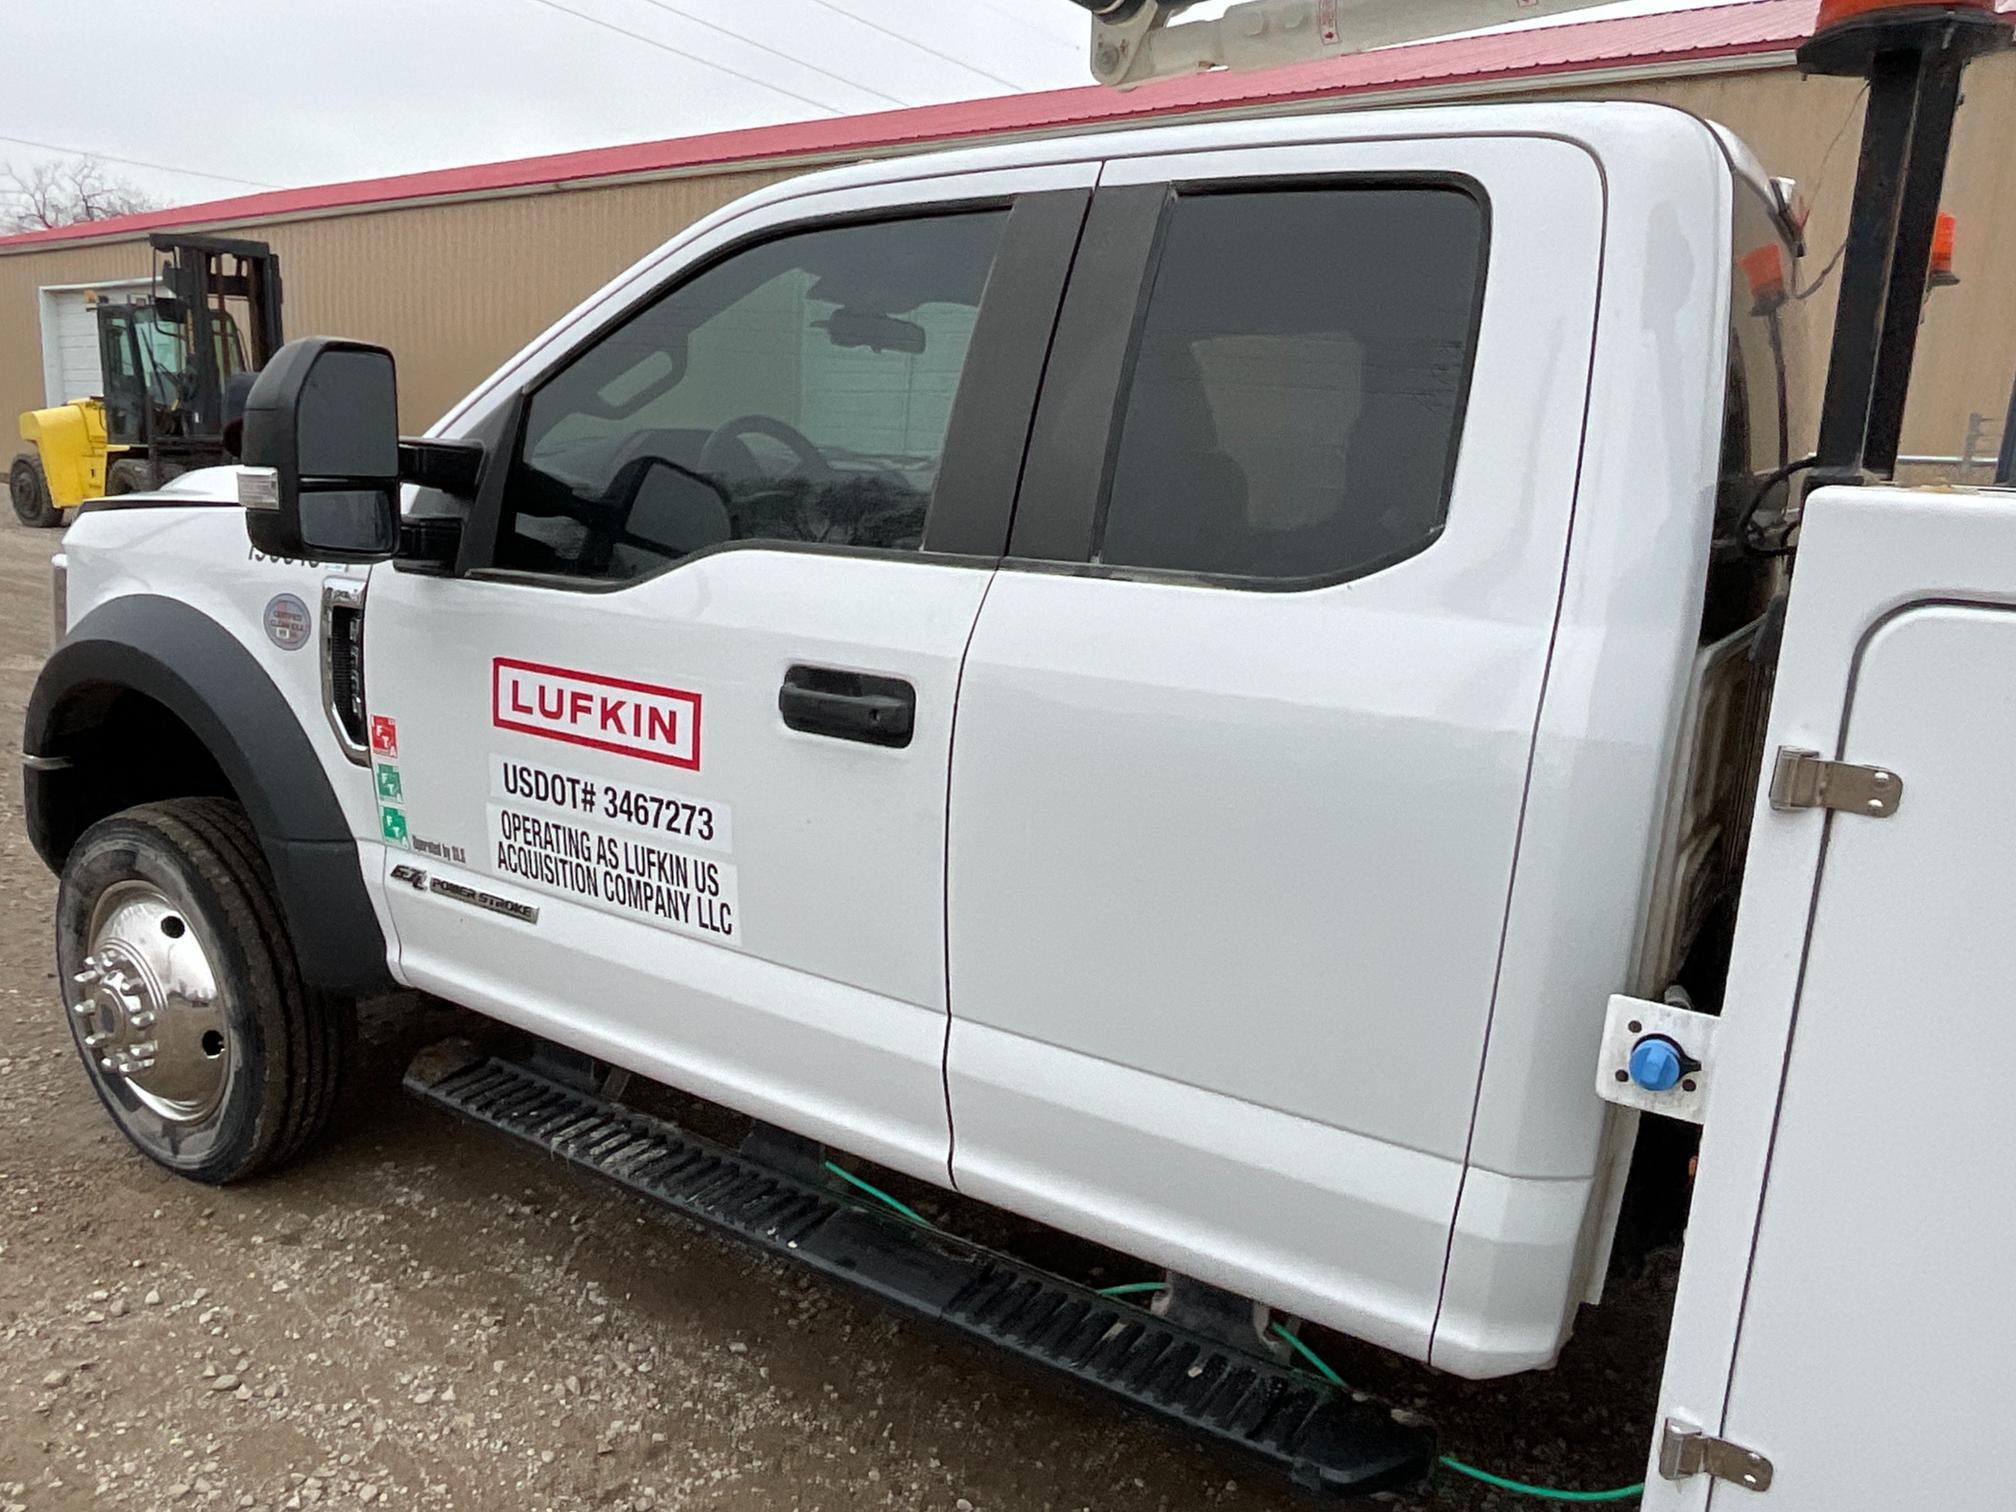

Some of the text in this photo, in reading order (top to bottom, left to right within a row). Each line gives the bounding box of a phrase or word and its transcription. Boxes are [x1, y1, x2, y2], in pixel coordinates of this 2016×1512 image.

[512, 680, 677, 745] LUFKIN
[503, 762, 714, 840] USDOT# 3467273
[498, 841, 732, 935] ACQUISITION COMPANY LLC
[501, 810, 591, 862] OPERATING
[596, 835, 619, 870] AS
[624, 842, 688, 889] LUFKIN
[694, 859, 719, 897] US
[432, 877, 476, 899] POWER
[479, 892, 532, 918] STROKE
